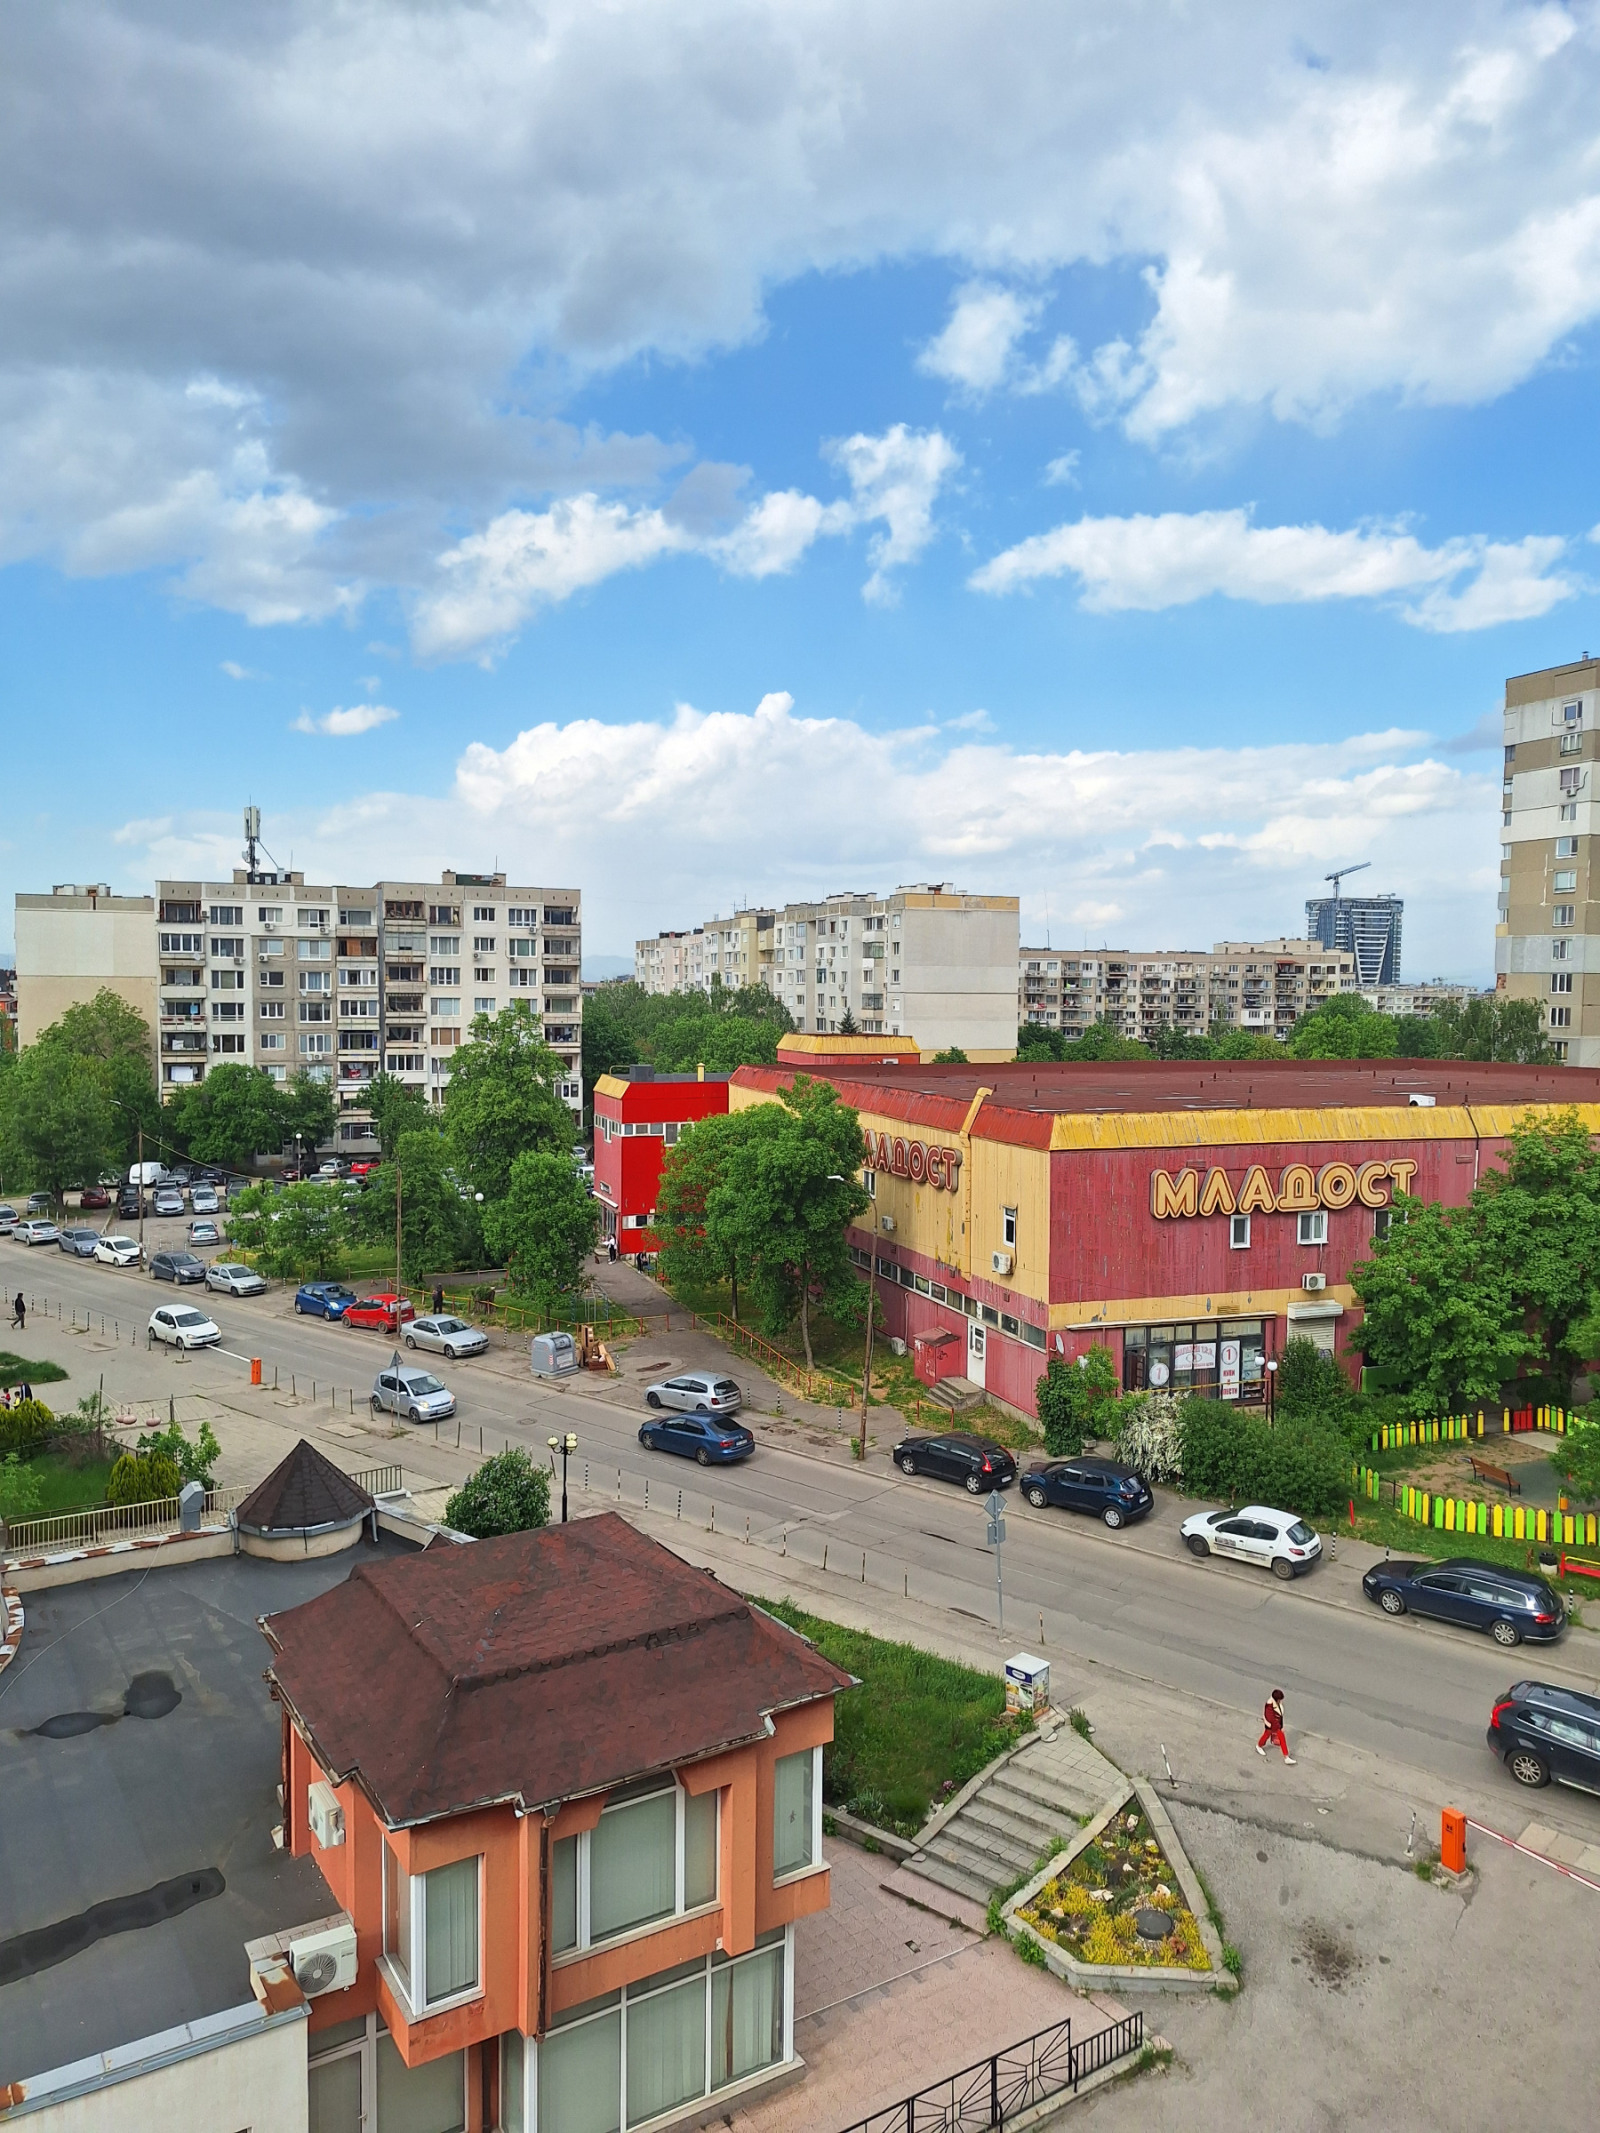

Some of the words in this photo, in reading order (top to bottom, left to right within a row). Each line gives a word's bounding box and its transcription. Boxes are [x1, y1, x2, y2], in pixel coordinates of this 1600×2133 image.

[861, 1127, 962, 1192] ЛАДОСТ
[1151, 1158, 1418, 1219] МЛАДОСТ
[1226, 1348, 1231, 1361] 1
